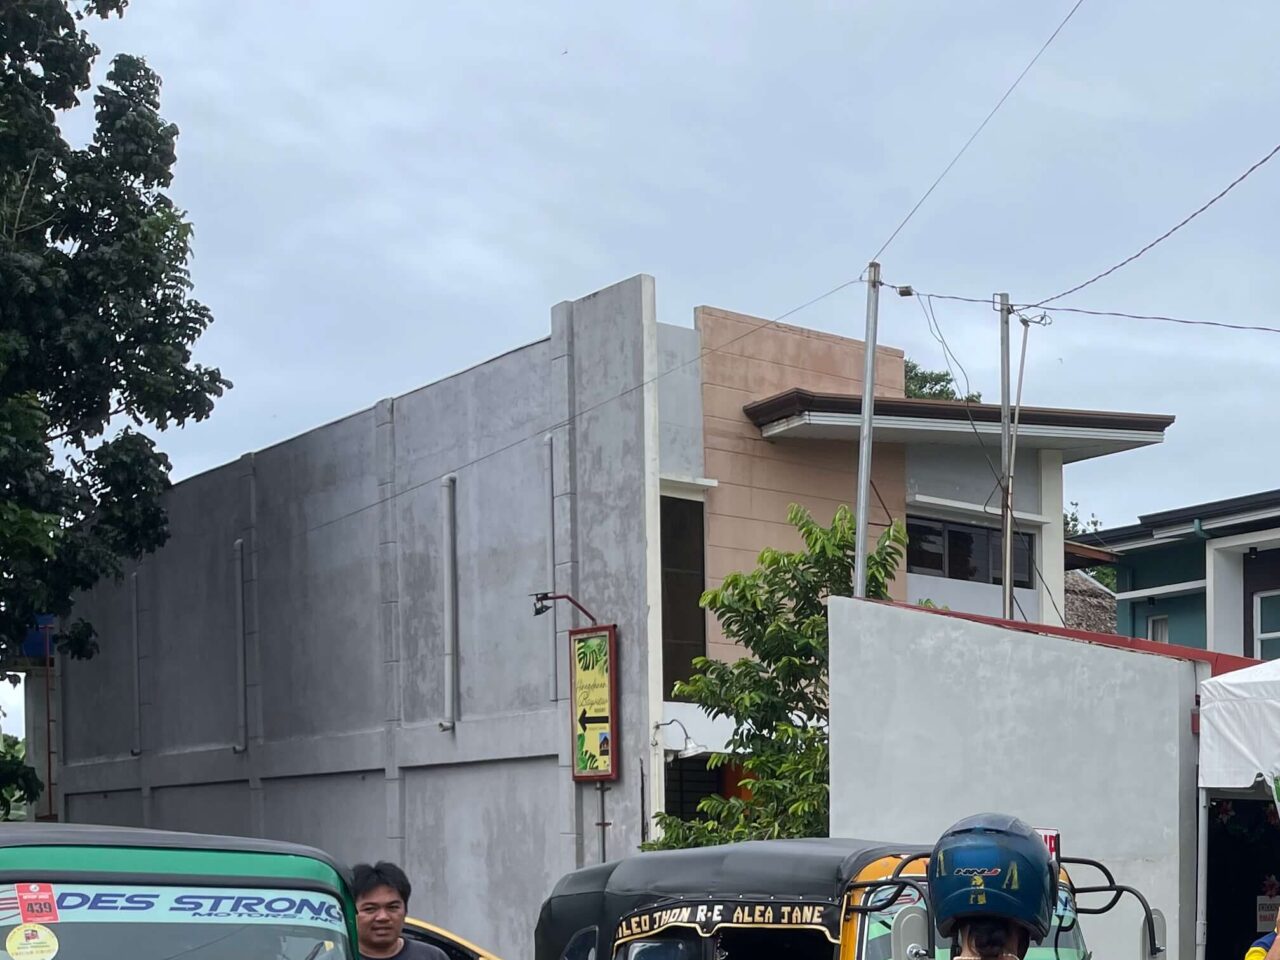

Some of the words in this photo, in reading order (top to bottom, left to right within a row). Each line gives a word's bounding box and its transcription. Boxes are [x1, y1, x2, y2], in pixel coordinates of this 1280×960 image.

[27, 901, 53, 913] 439
[57, 892, 160, 911] DES
[169, 895, 342, 922] STRONG
[653, 907, 692, 929] JHON
[733, 905, 774, 923] ALEA
[781, 906, 824, 923] JANE
